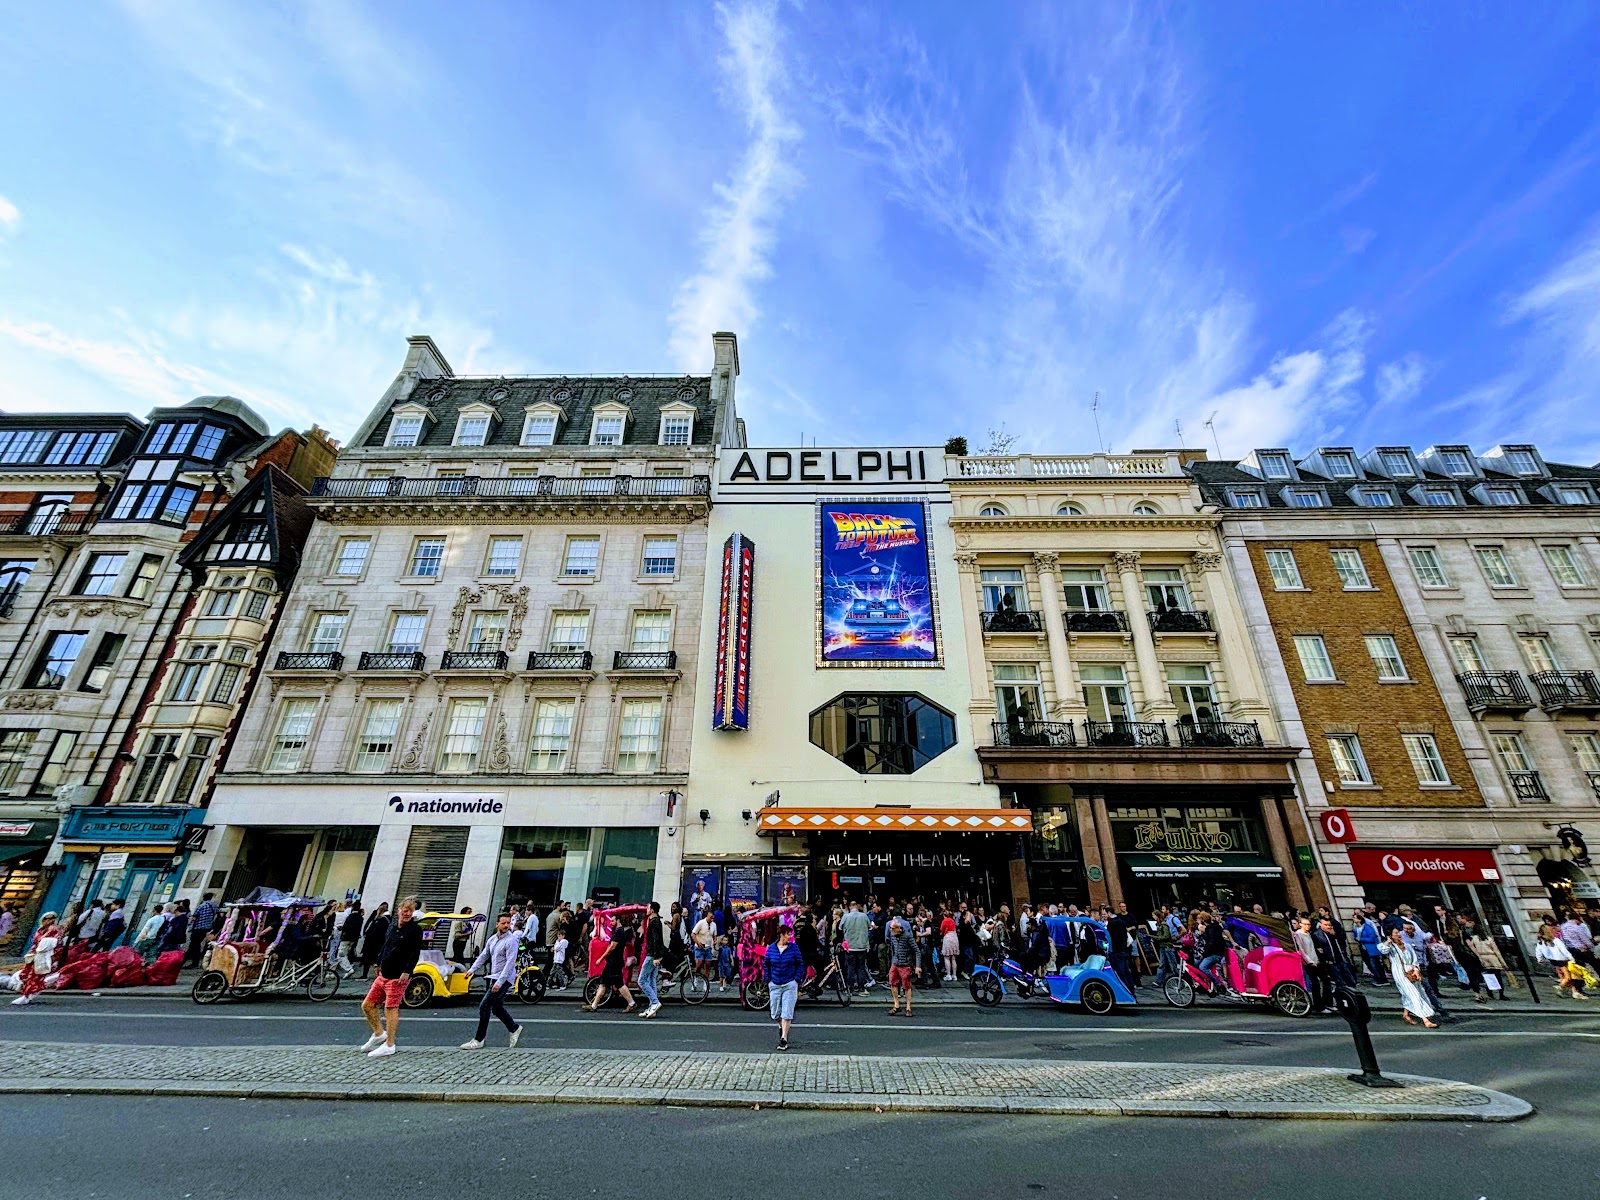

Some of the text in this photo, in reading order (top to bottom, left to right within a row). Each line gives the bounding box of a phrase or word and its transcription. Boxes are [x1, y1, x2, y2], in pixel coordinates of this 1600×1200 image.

[730, 450, 926, 481] ADELPHI
[828, 511, 904, 532] BACK
[838, 528, 917, 546] TO FUTURE
[889, 540, 917, 549] MUSICAL
[835, 541, 857, 551] THE
[740, 616, 748, 685] FUTURE
[407, 798, 503, 813] nationwide
[827, 853, 971, 867] ADELPHI THEATRE
[1405, 858, 1465, 871] vodafone
